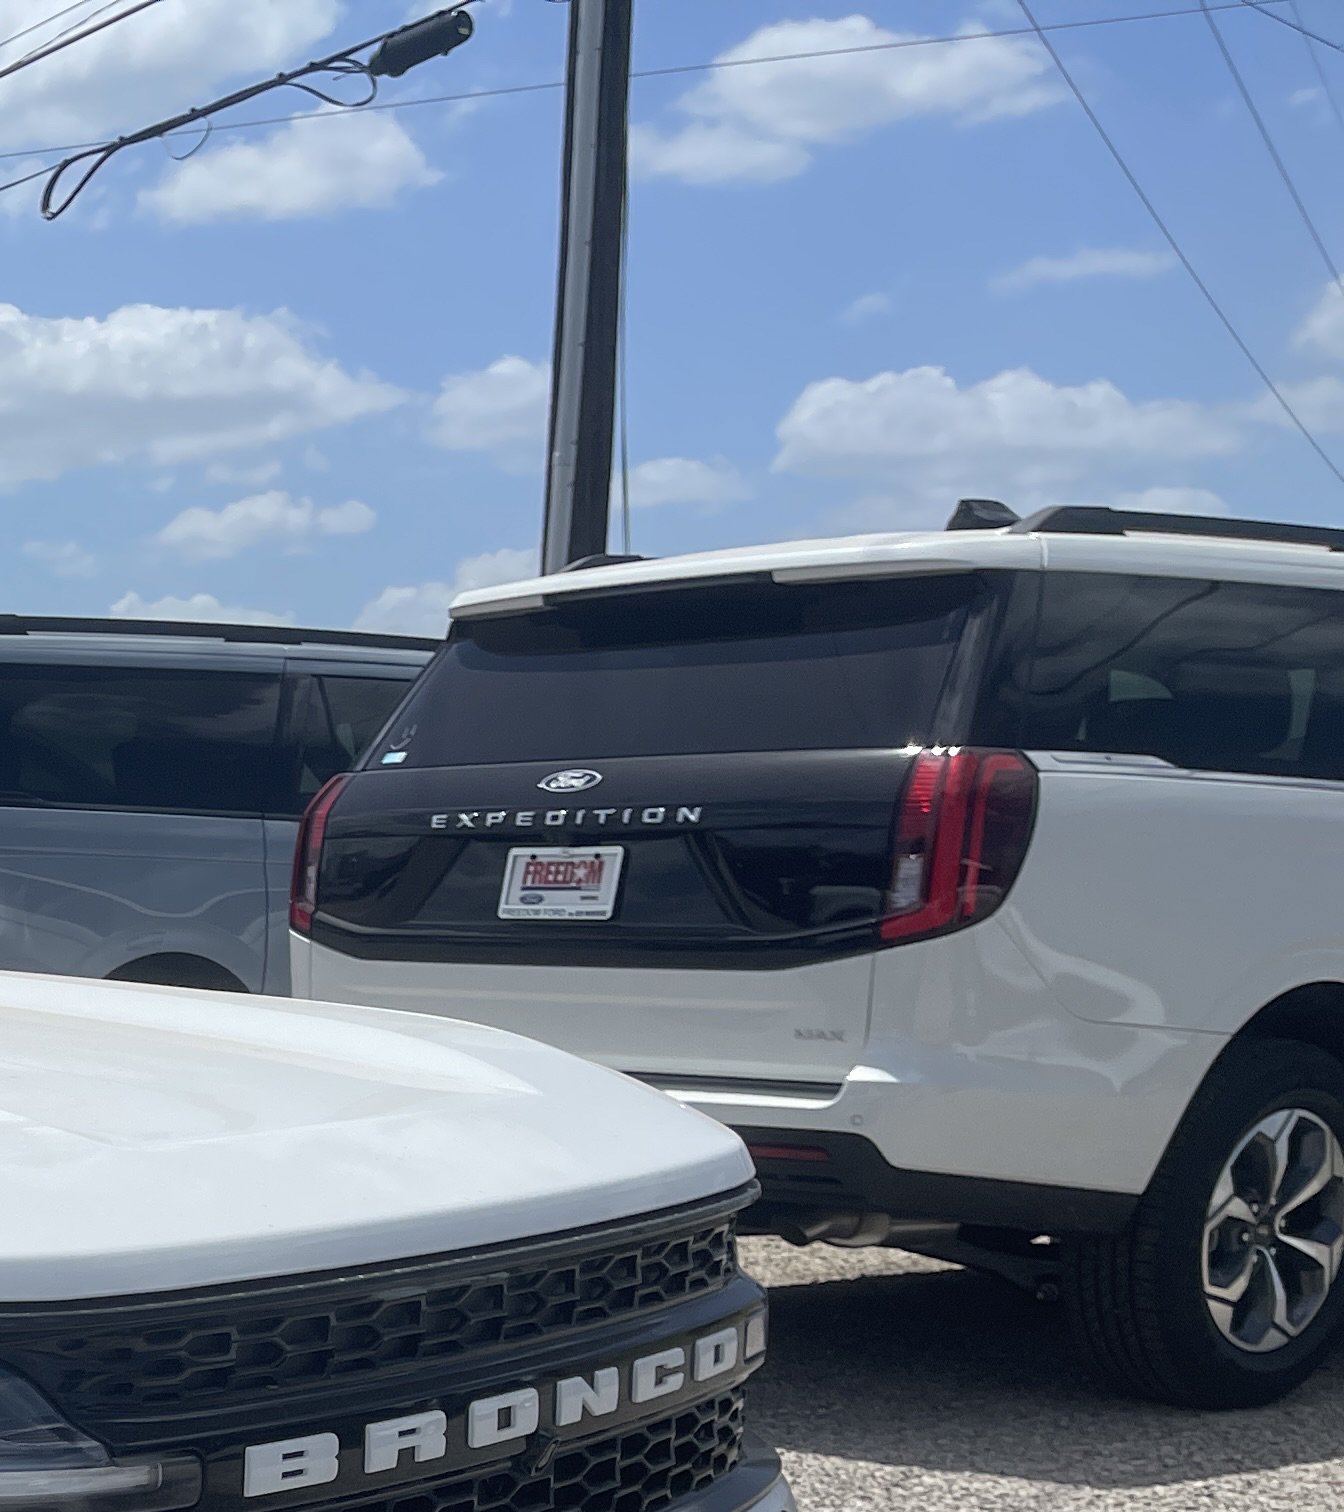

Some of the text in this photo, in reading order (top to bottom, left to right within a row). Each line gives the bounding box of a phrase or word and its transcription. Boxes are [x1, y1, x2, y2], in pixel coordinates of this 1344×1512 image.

[430, 806, 703, 829] EXPEDITION
[522, 861, 604, 885] FREEDOM
[243, 1327, 739, 1498] BRONCO
